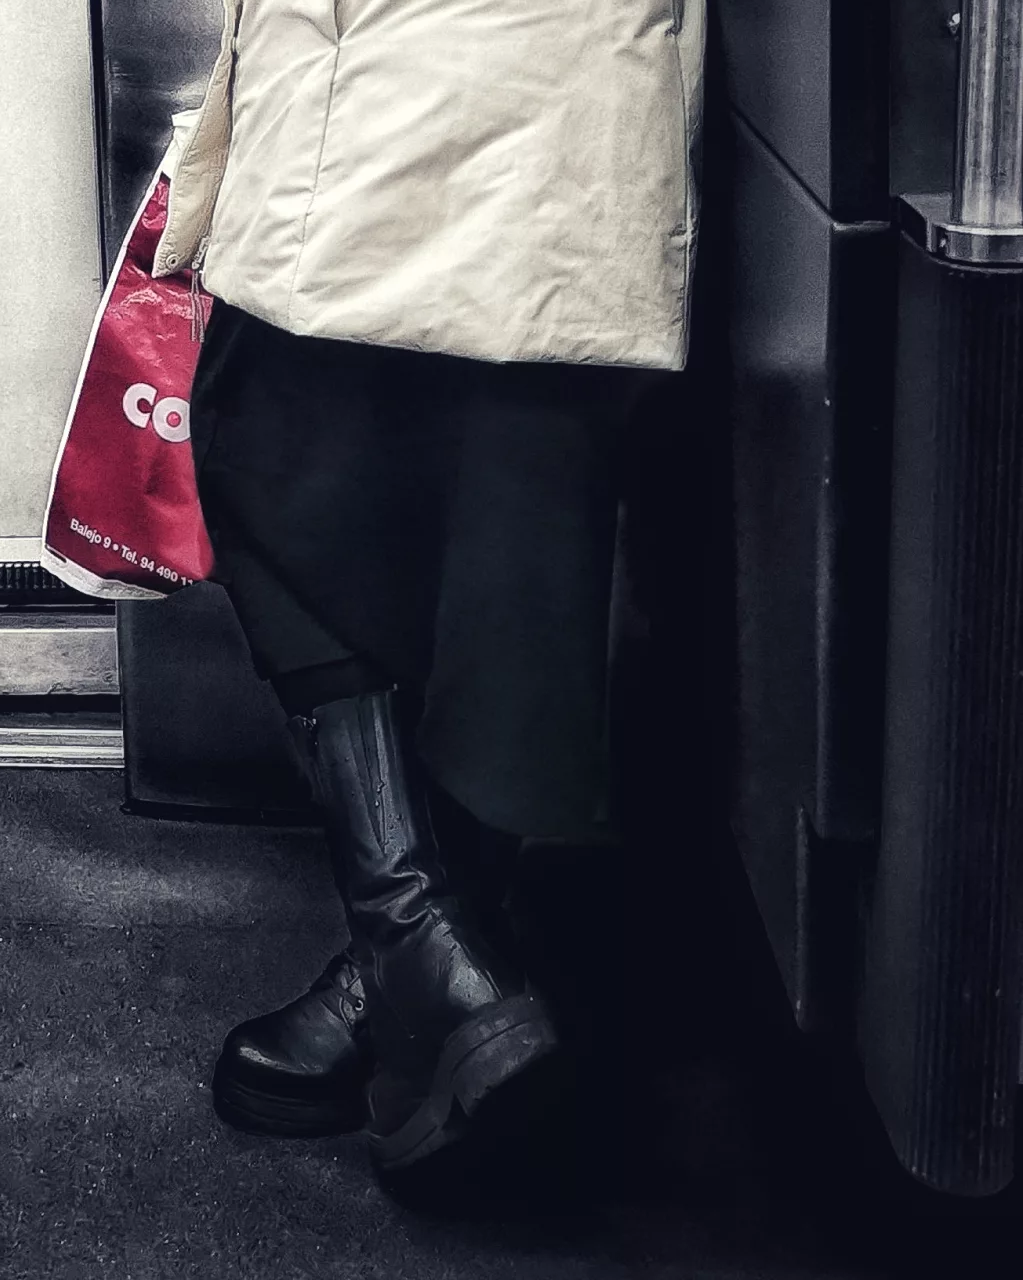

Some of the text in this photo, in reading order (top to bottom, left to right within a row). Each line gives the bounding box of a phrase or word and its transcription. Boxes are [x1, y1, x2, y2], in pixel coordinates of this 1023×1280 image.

[70, 518, 102, 544] Balejo
[103, 536, 112, 549] 9
[121, 544, 138, 565] Tel.
[140, 556, 155, 572] 94
[156, 565, 179, 583] 490
